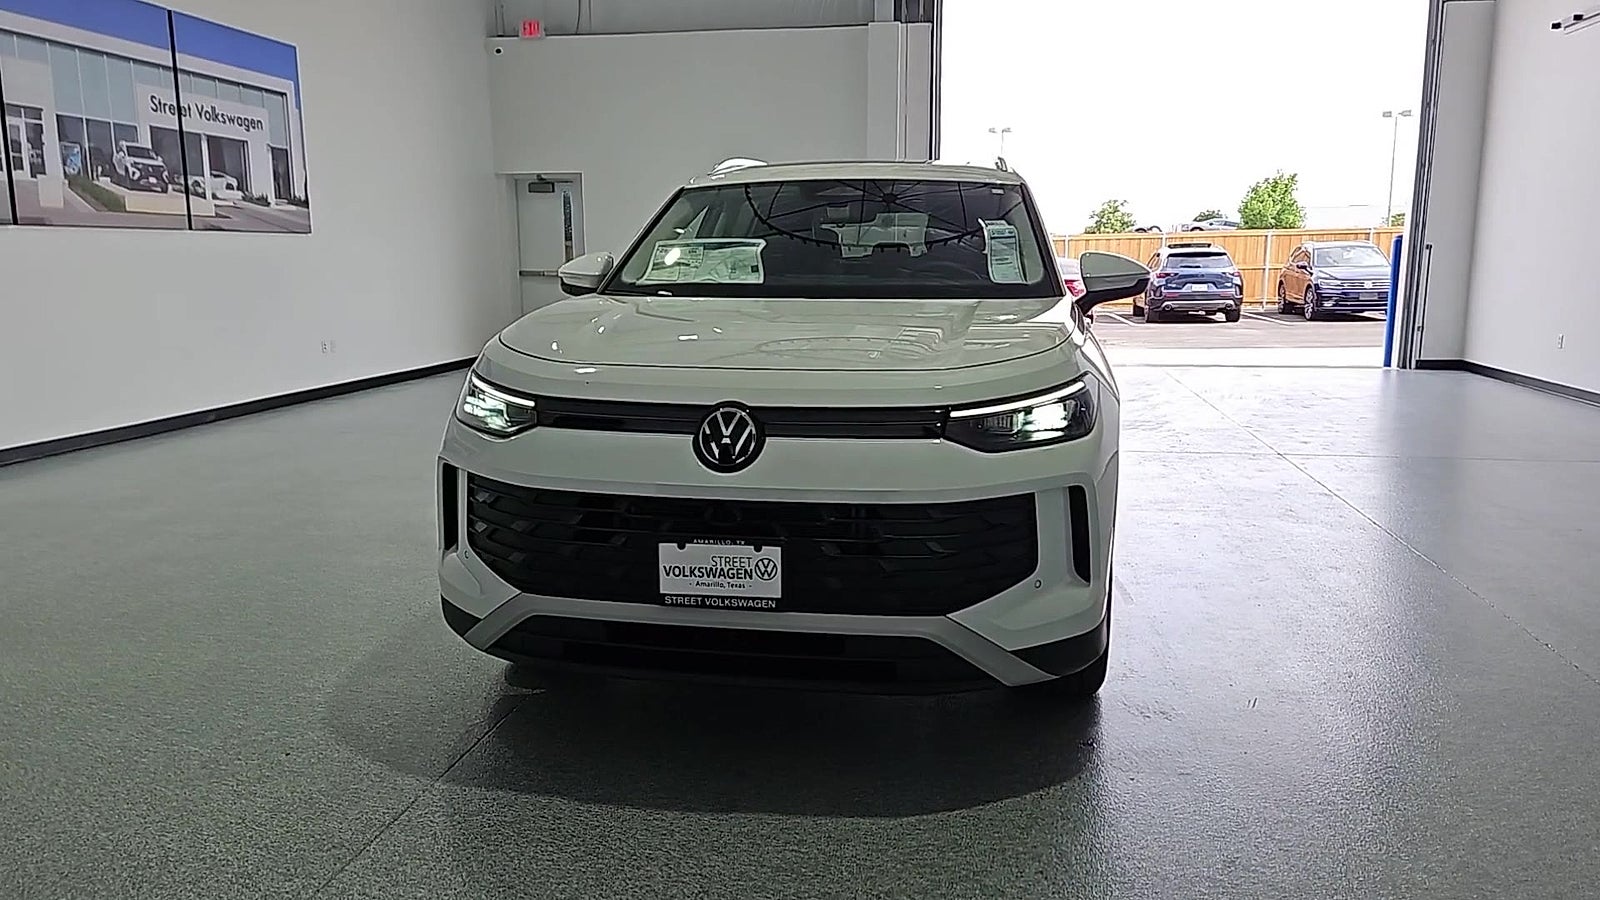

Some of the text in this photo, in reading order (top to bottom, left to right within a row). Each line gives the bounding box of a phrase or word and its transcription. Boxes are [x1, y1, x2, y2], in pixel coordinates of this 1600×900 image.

[150, 94, 264, 132] Street Volkswagen
[711, 555, 753, 568] STREET
[663, 565, 753, 580] VOLKSWAGEN
[665, 595, 776, 608] STREET VOLKSWAGEN
